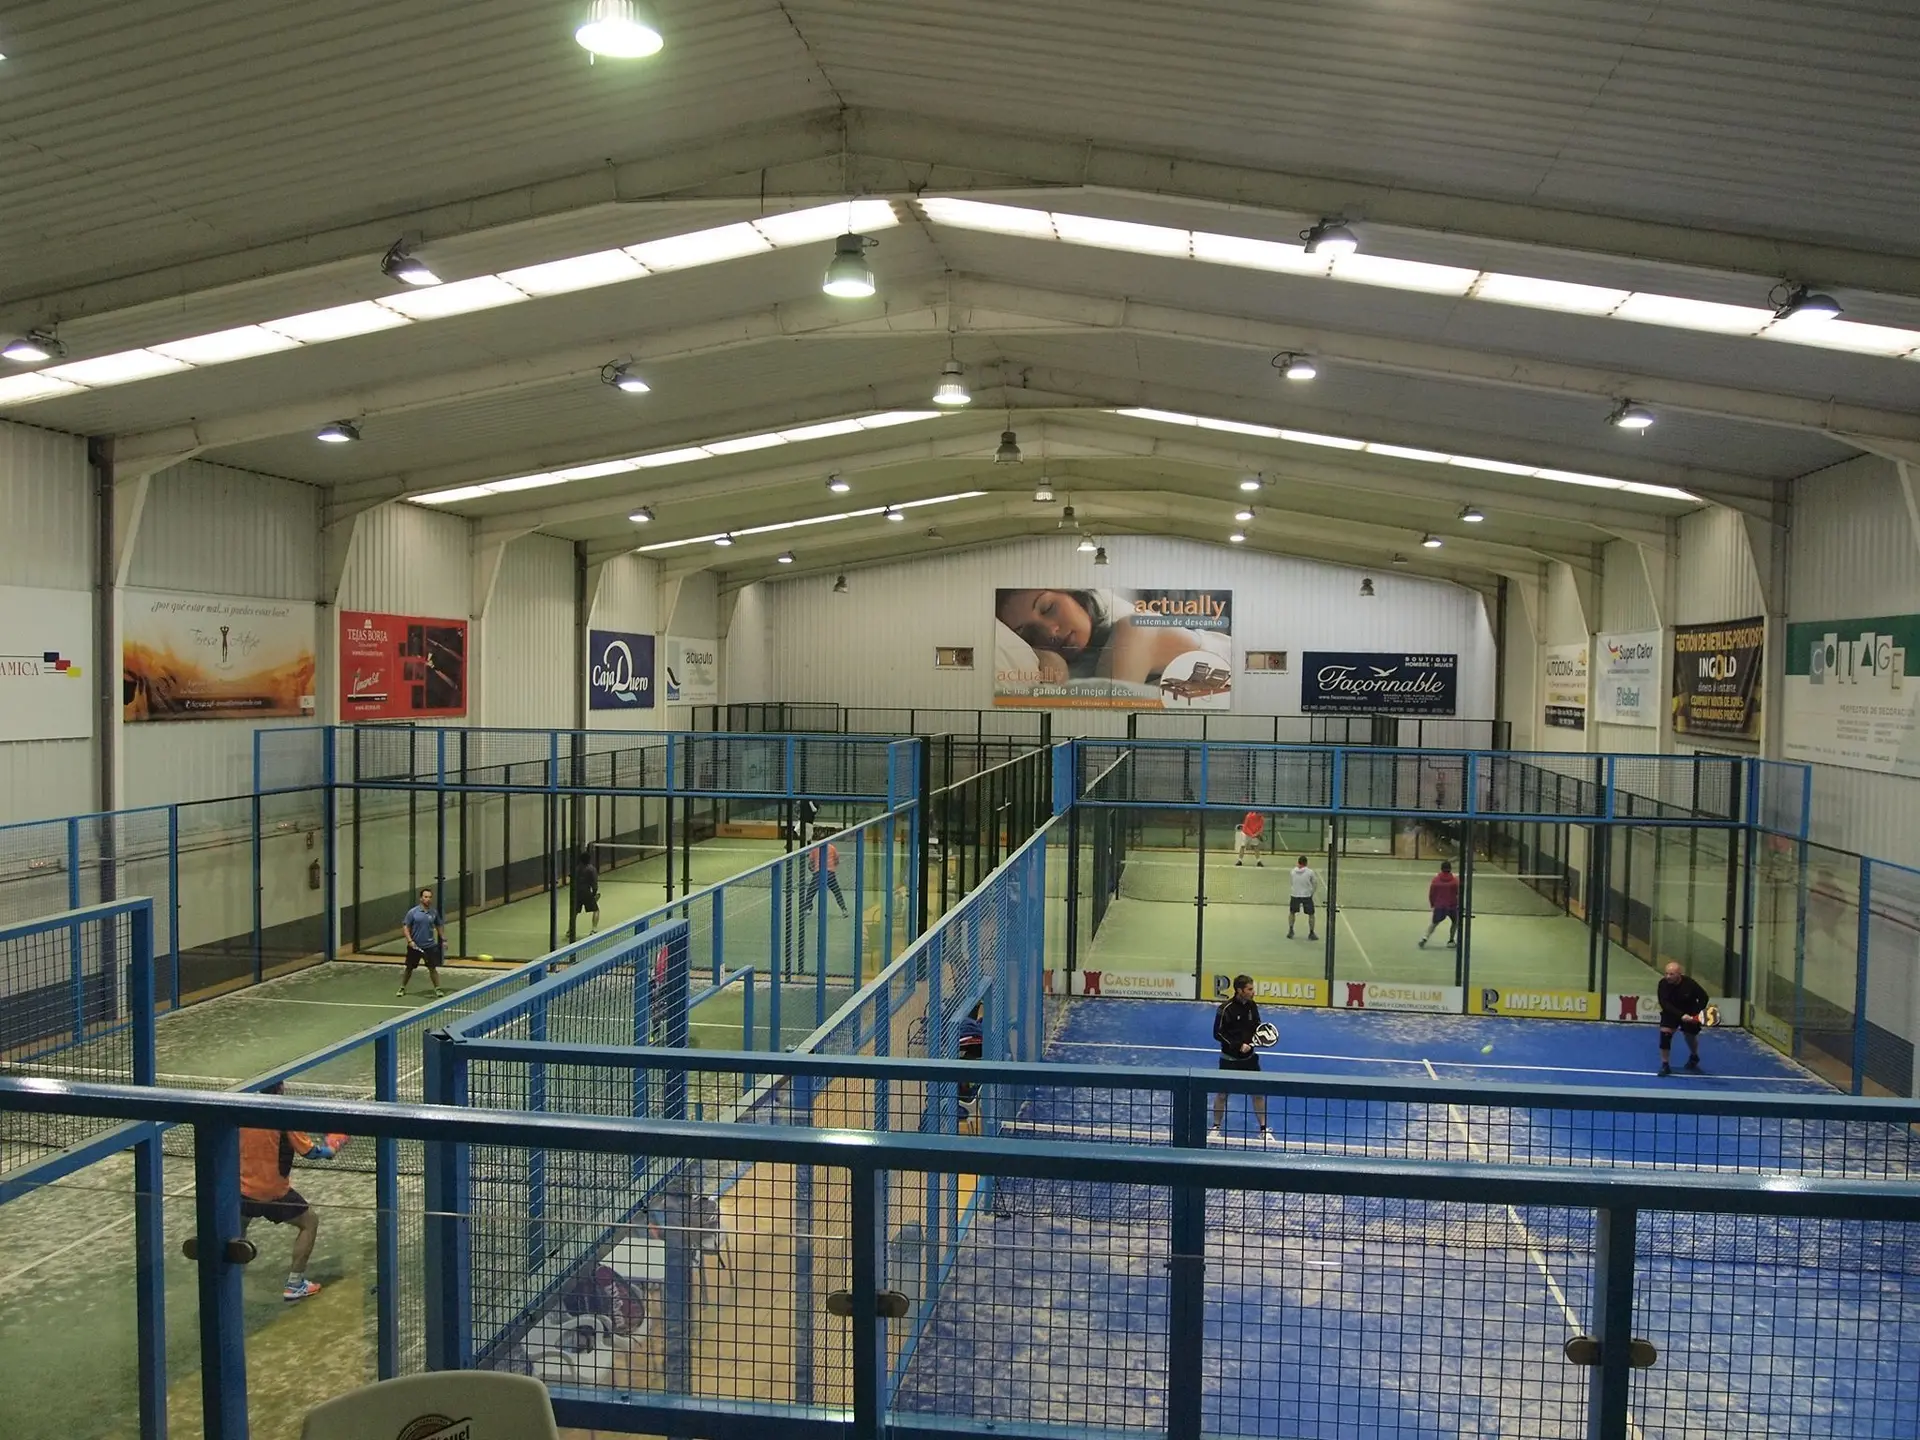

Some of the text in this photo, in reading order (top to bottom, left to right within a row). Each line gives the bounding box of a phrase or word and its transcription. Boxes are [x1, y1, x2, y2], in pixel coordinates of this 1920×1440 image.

[1135, 595, 1226, 621] actually
[1136, 618, 1223, 627] sistemas de descanso
[347, 629, 388, 643] TEJAS BORJA
[686, 651, 713, 665] acuauto
[1620, 645, 1635, 664] Super
[1699, 654, 1737, 680] INGOLD
[1812, 641, 1903, 690] COLLAGE
[593, 664, 615, 692] Caja
[997, 667, 1064, 685] actually
[1317, 665, 1446, 695] Façonnable
[1033, 686, 1067, 697] ganado
[1070, 686, 1079, 695] el
[1081, 686, 1109, 697] mejor
[1104, 973, 1175, 988] CASTELIUM
[1368, 985, 1442, 1002] CASTELIUM
[1506, 993, 1588, 1012] IMPALAG
